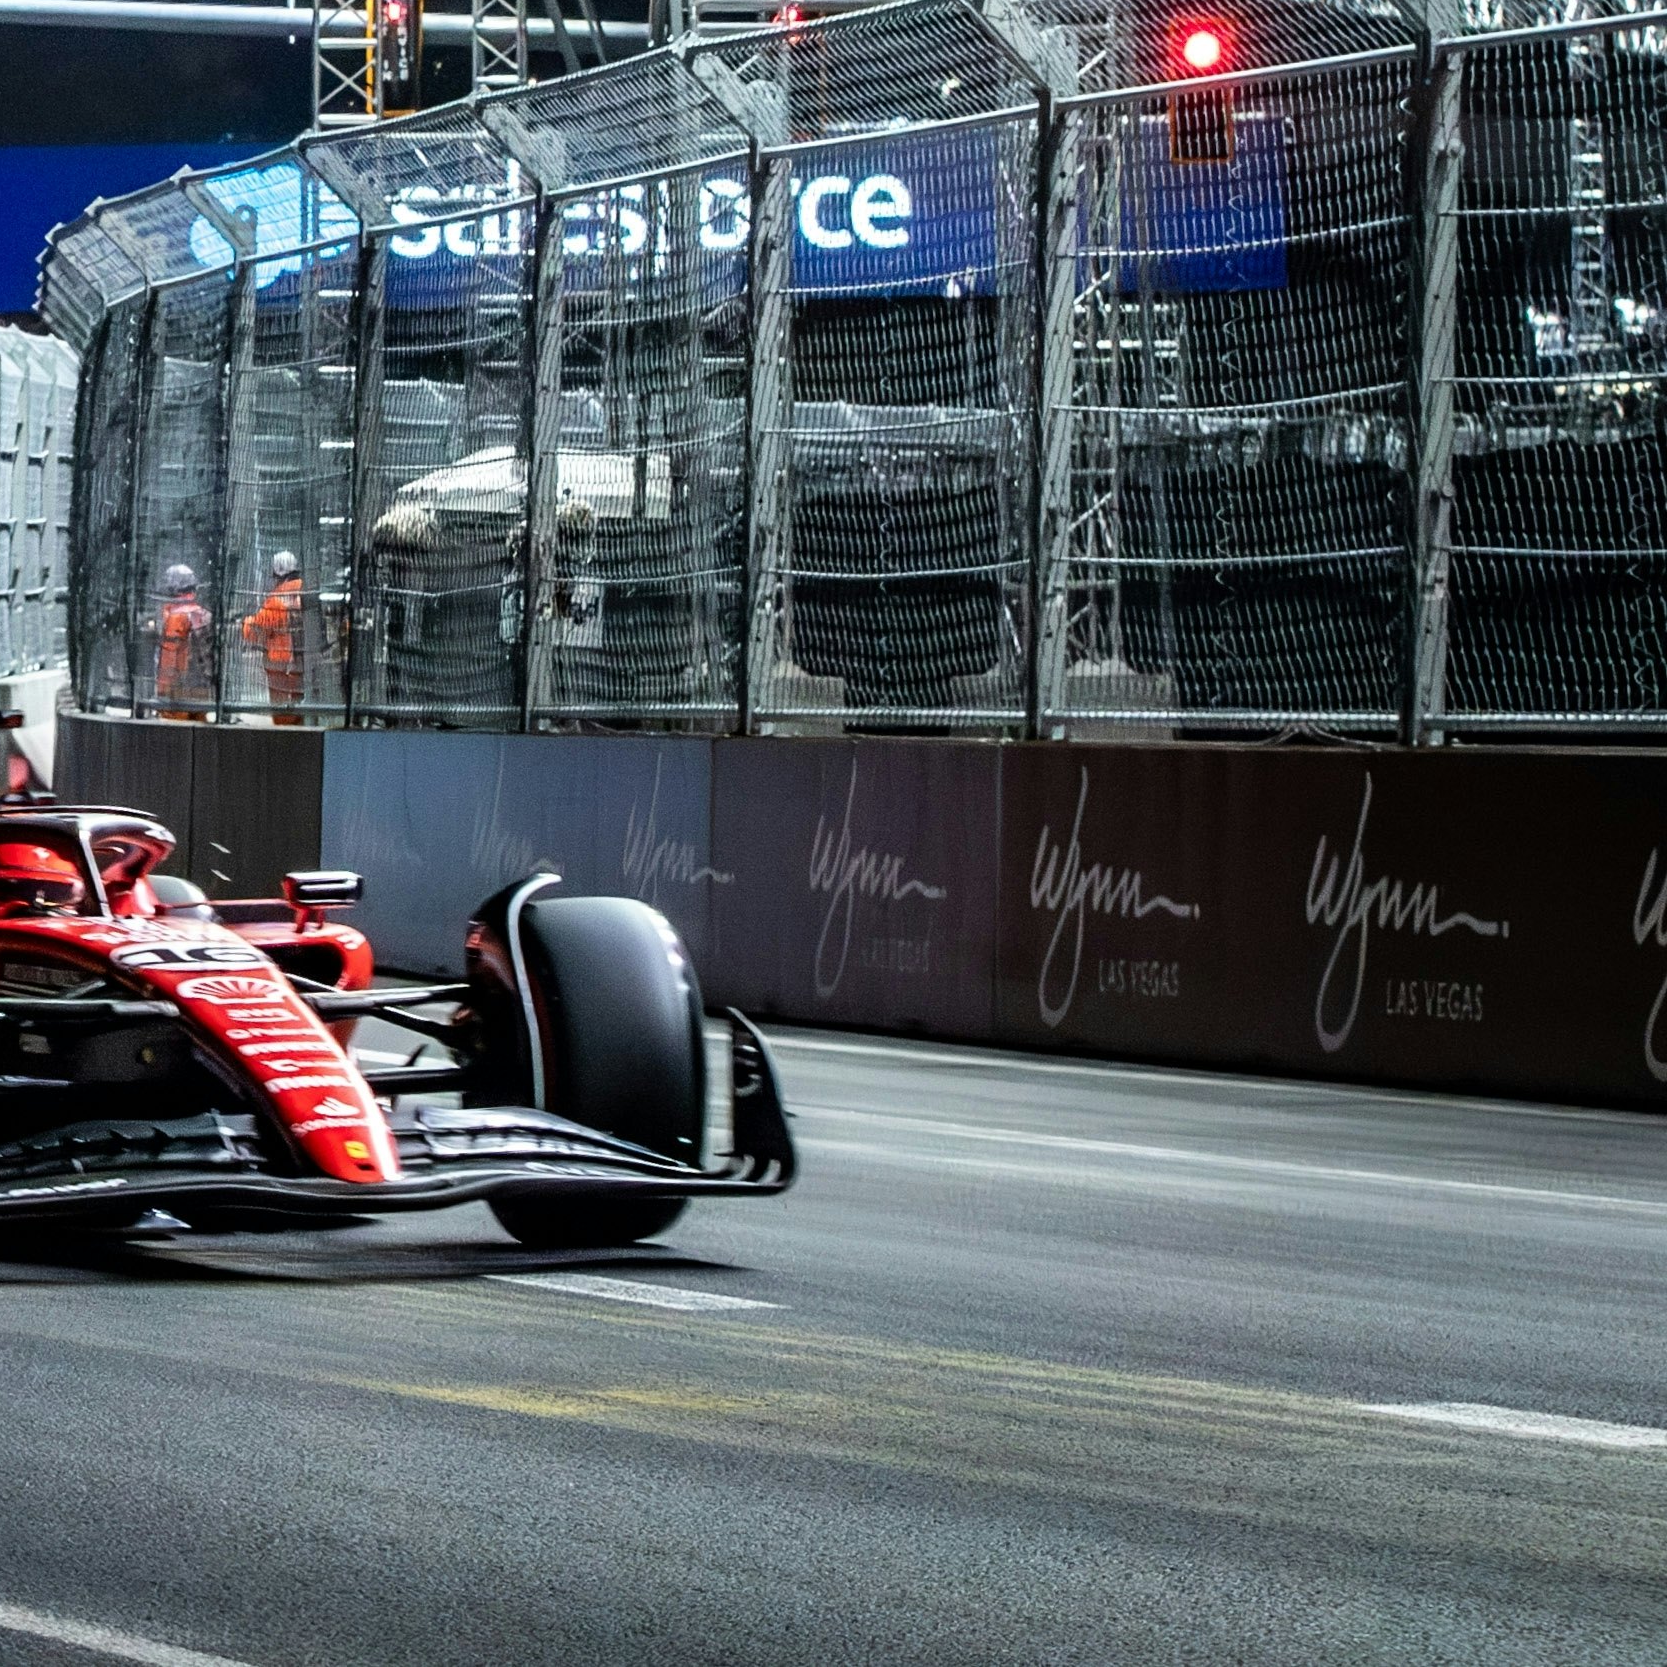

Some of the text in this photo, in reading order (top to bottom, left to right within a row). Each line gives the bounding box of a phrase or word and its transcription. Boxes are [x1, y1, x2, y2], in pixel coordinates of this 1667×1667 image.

[119, 946, 261, 966] 16
[809, 756, 948, 998] Wynn
[1030, 765, 1193, 1029] Wynn
[1305, 771, 1501, 1053] Wynn
[1385, 980, 1484, 1023] LAS VEGAS
